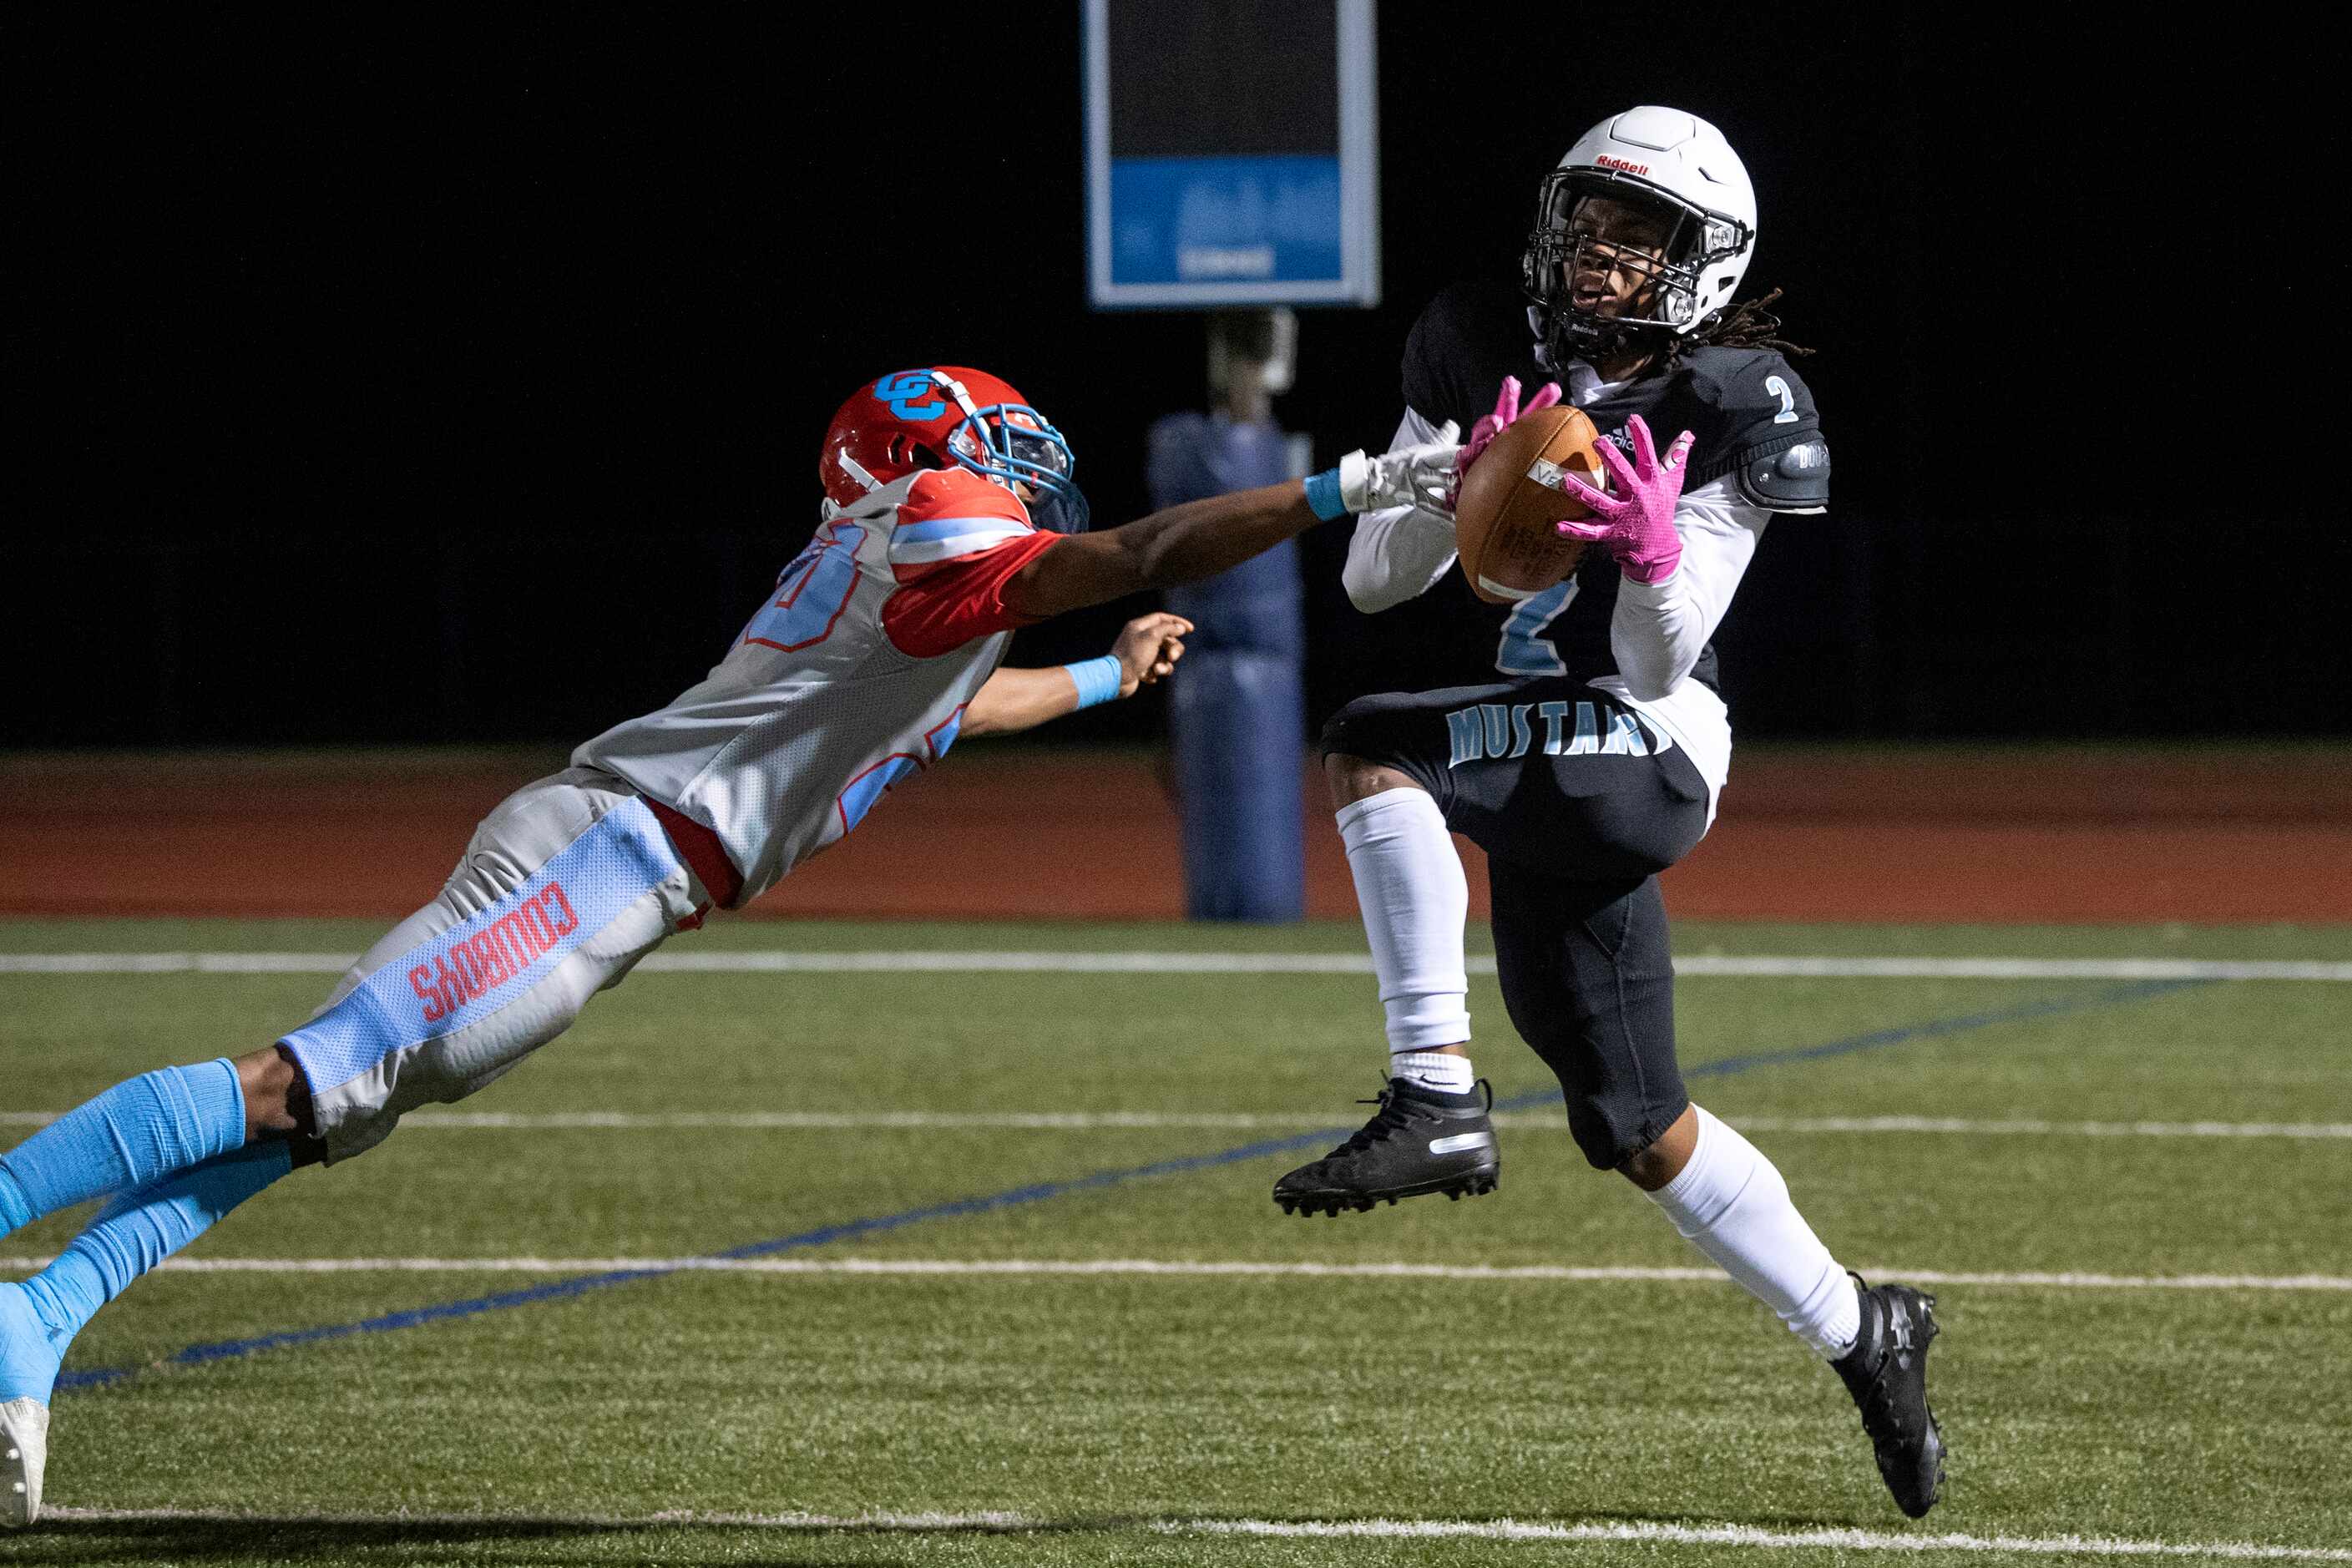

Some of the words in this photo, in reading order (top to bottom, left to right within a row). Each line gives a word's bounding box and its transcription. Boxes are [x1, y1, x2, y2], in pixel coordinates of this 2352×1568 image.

[1596, 154, 1649, 176] Riddell
[1765, 376, 1799, 424] 2
[407, 881, 579, 1024] COWBOYS
